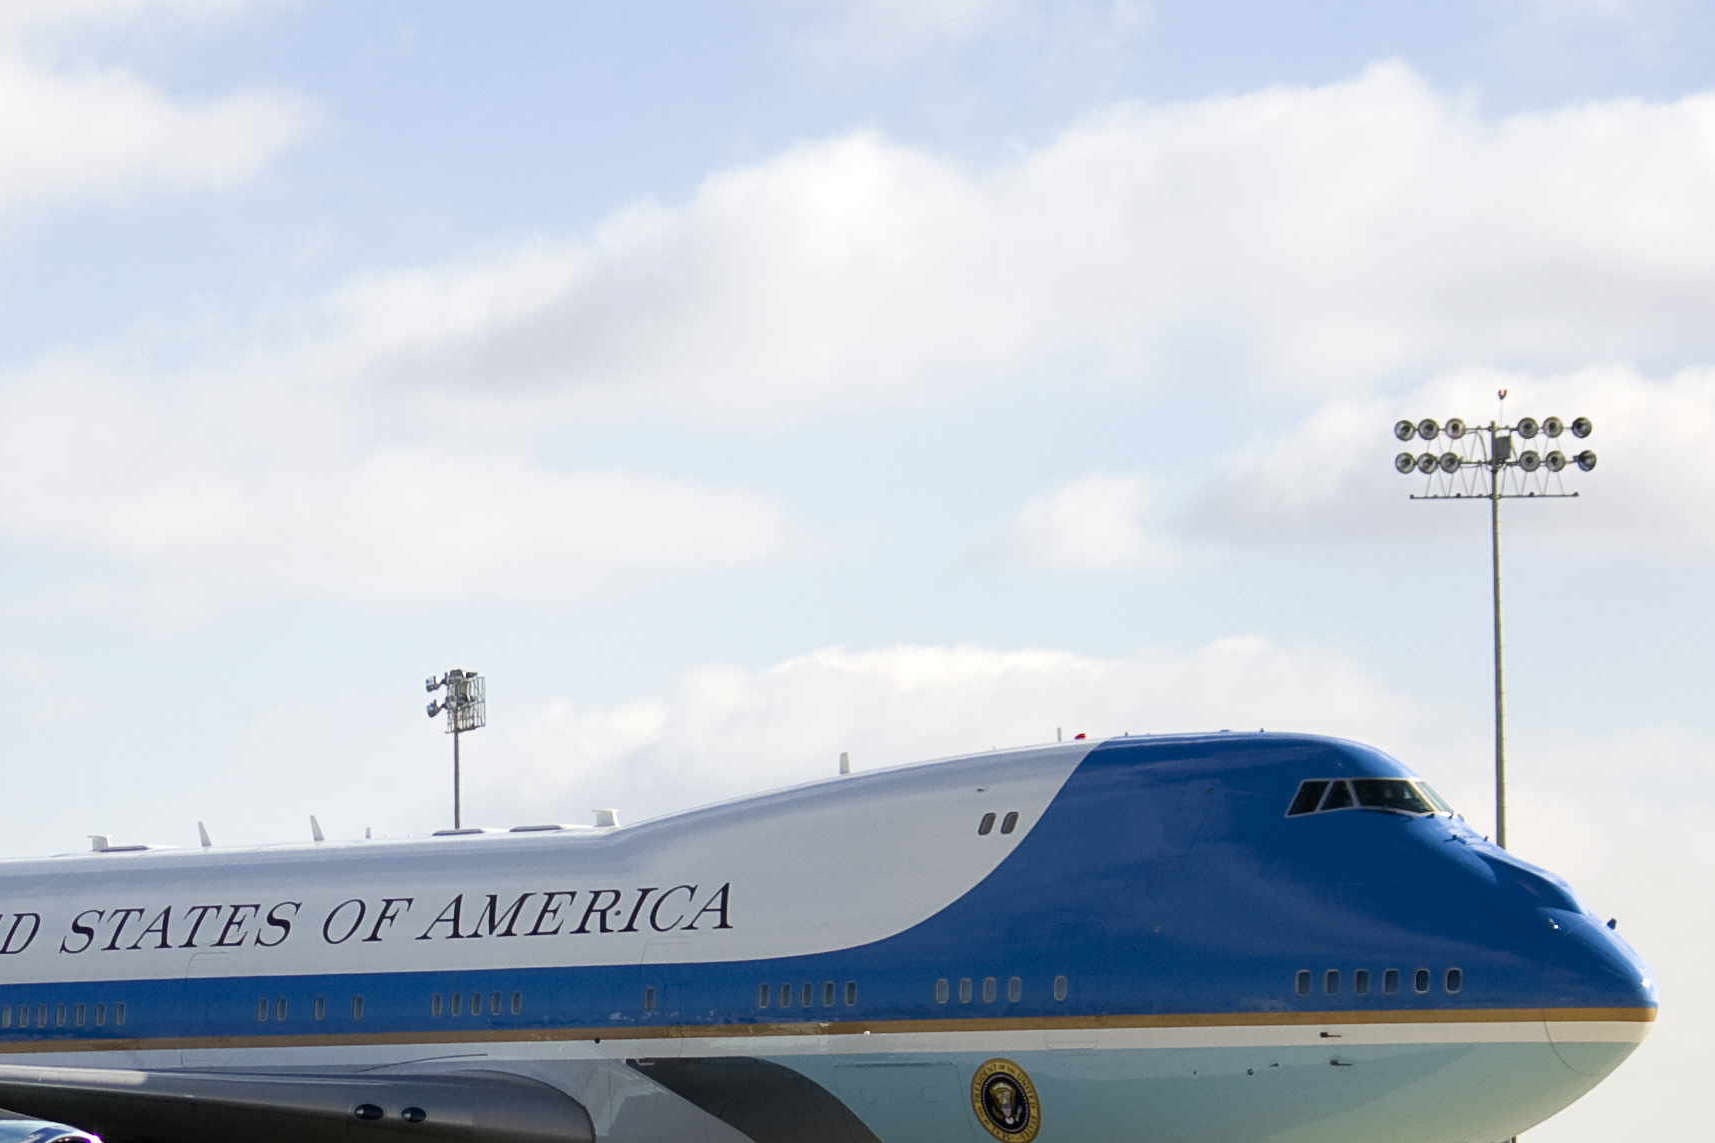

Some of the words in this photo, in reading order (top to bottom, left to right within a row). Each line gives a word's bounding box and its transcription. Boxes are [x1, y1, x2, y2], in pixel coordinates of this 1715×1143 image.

[59, 901, 302, 954] STATES
[322, 897, 413, 945] OF
[415, 882, 735, 941] AMERICA
